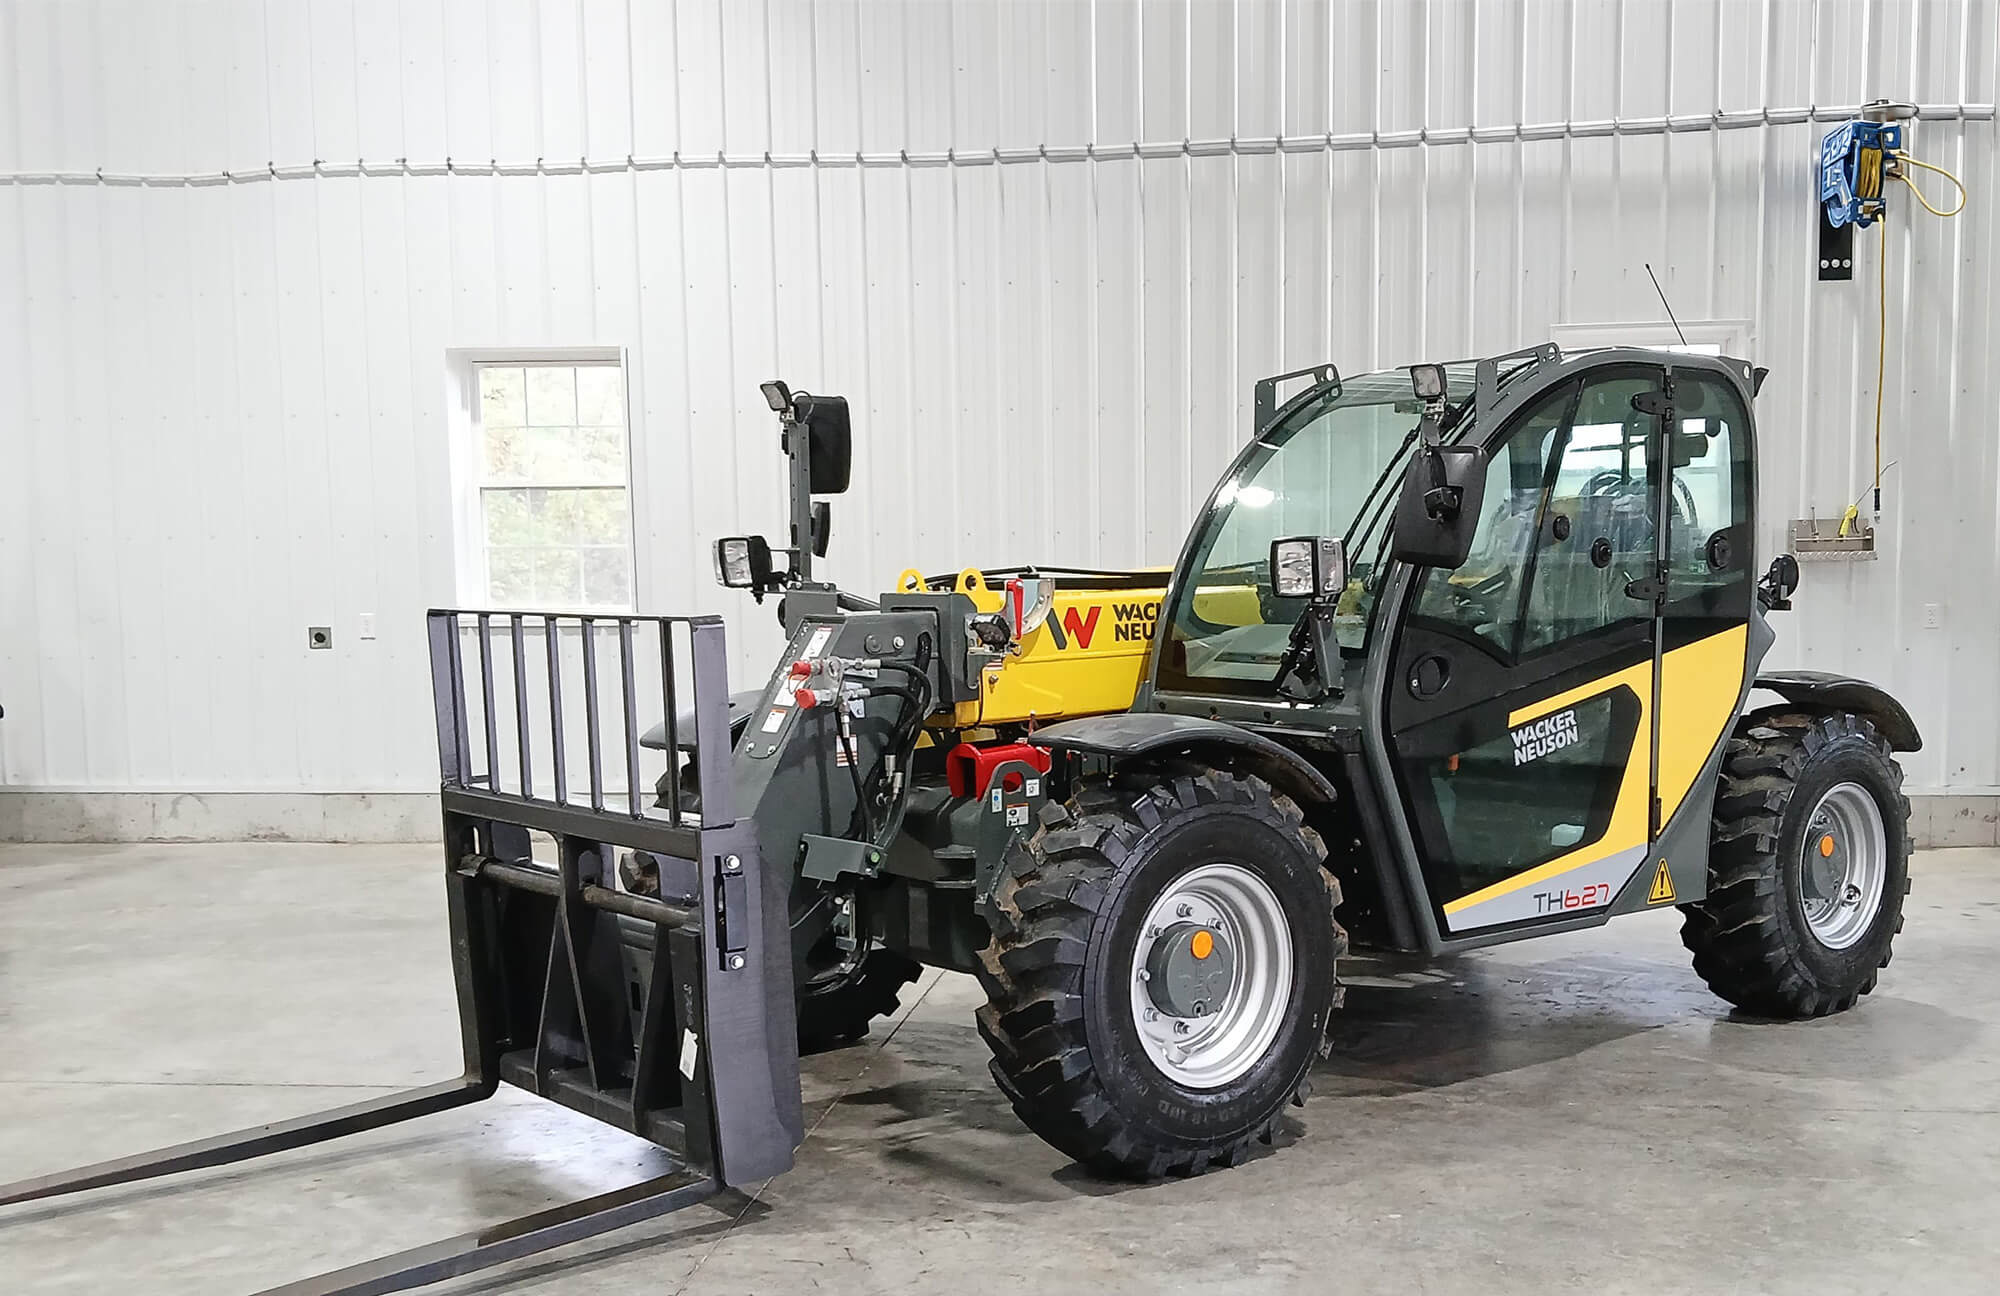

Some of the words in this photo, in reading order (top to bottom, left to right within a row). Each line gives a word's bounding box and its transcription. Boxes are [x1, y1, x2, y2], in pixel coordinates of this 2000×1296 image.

[1511, 710, 1577, 747] WACKER
[1514, 726, 1579, 766] NEUSON
[1533, 883, 1610, 913] TH627
